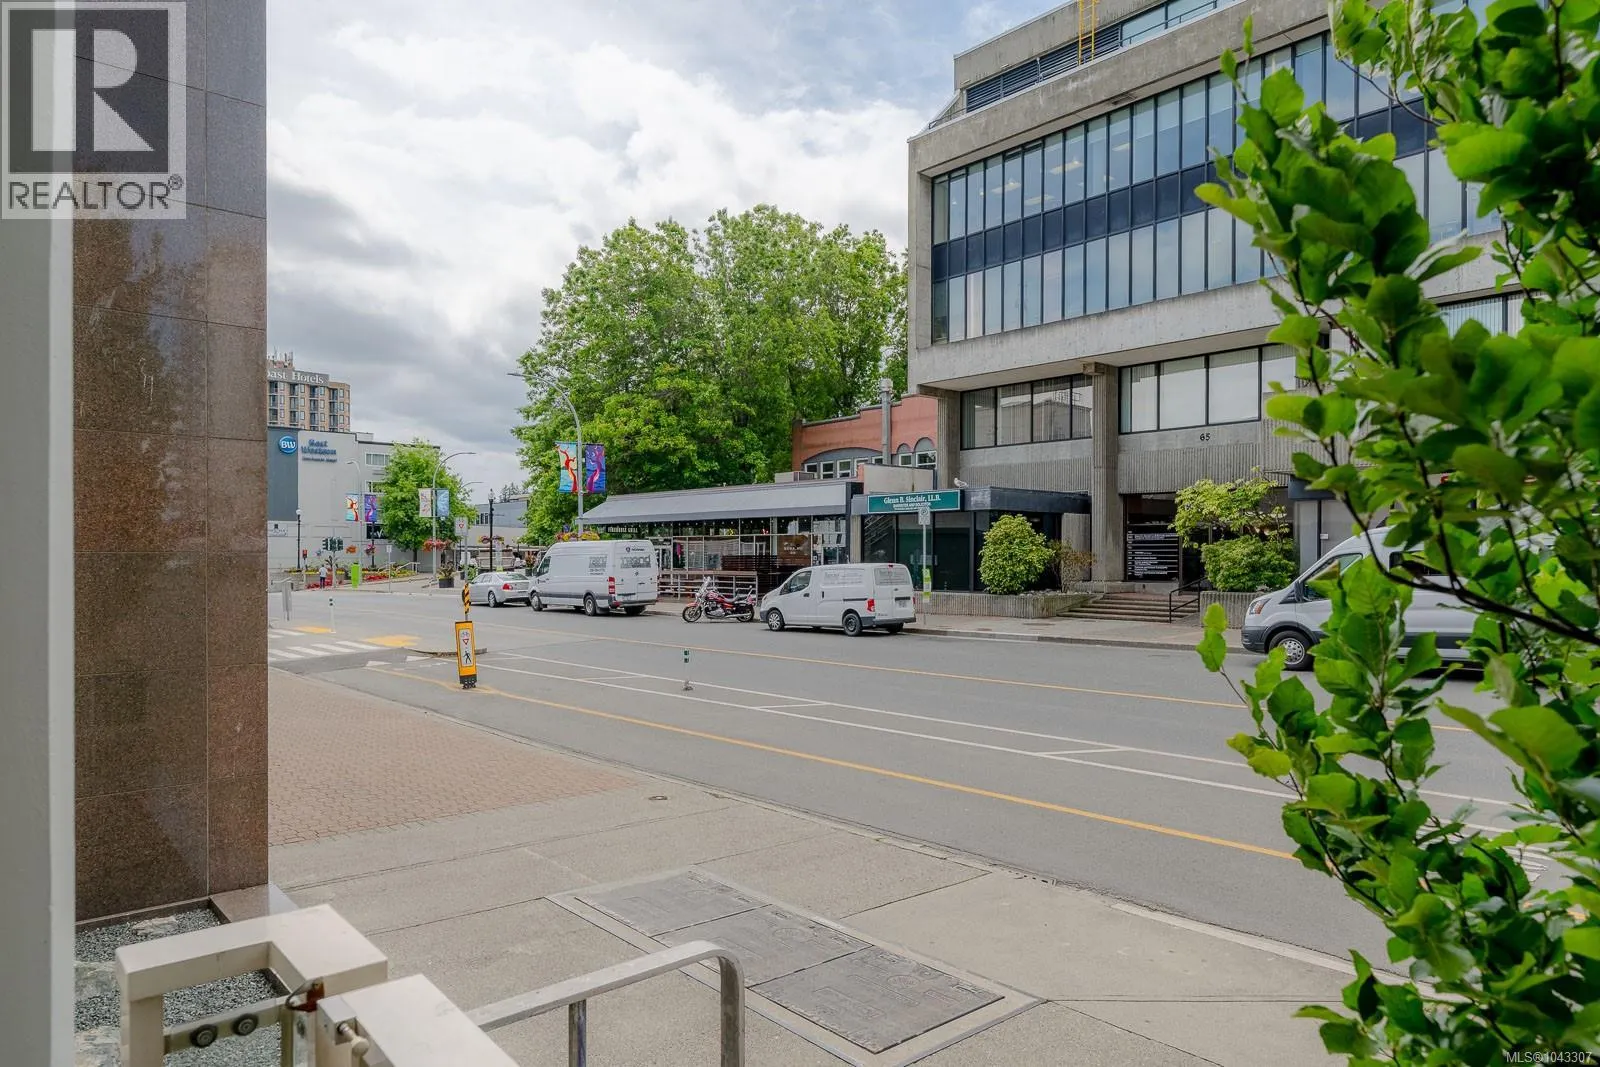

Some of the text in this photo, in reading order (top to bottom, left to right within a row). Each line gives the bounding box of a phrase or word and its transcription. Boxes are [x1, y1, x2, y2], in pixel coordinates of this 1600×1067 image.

[267, 370, 324, 384] oast Hotels
[1200, 433, 1211, 441] 65
[281, 440, 296, 449] BW
